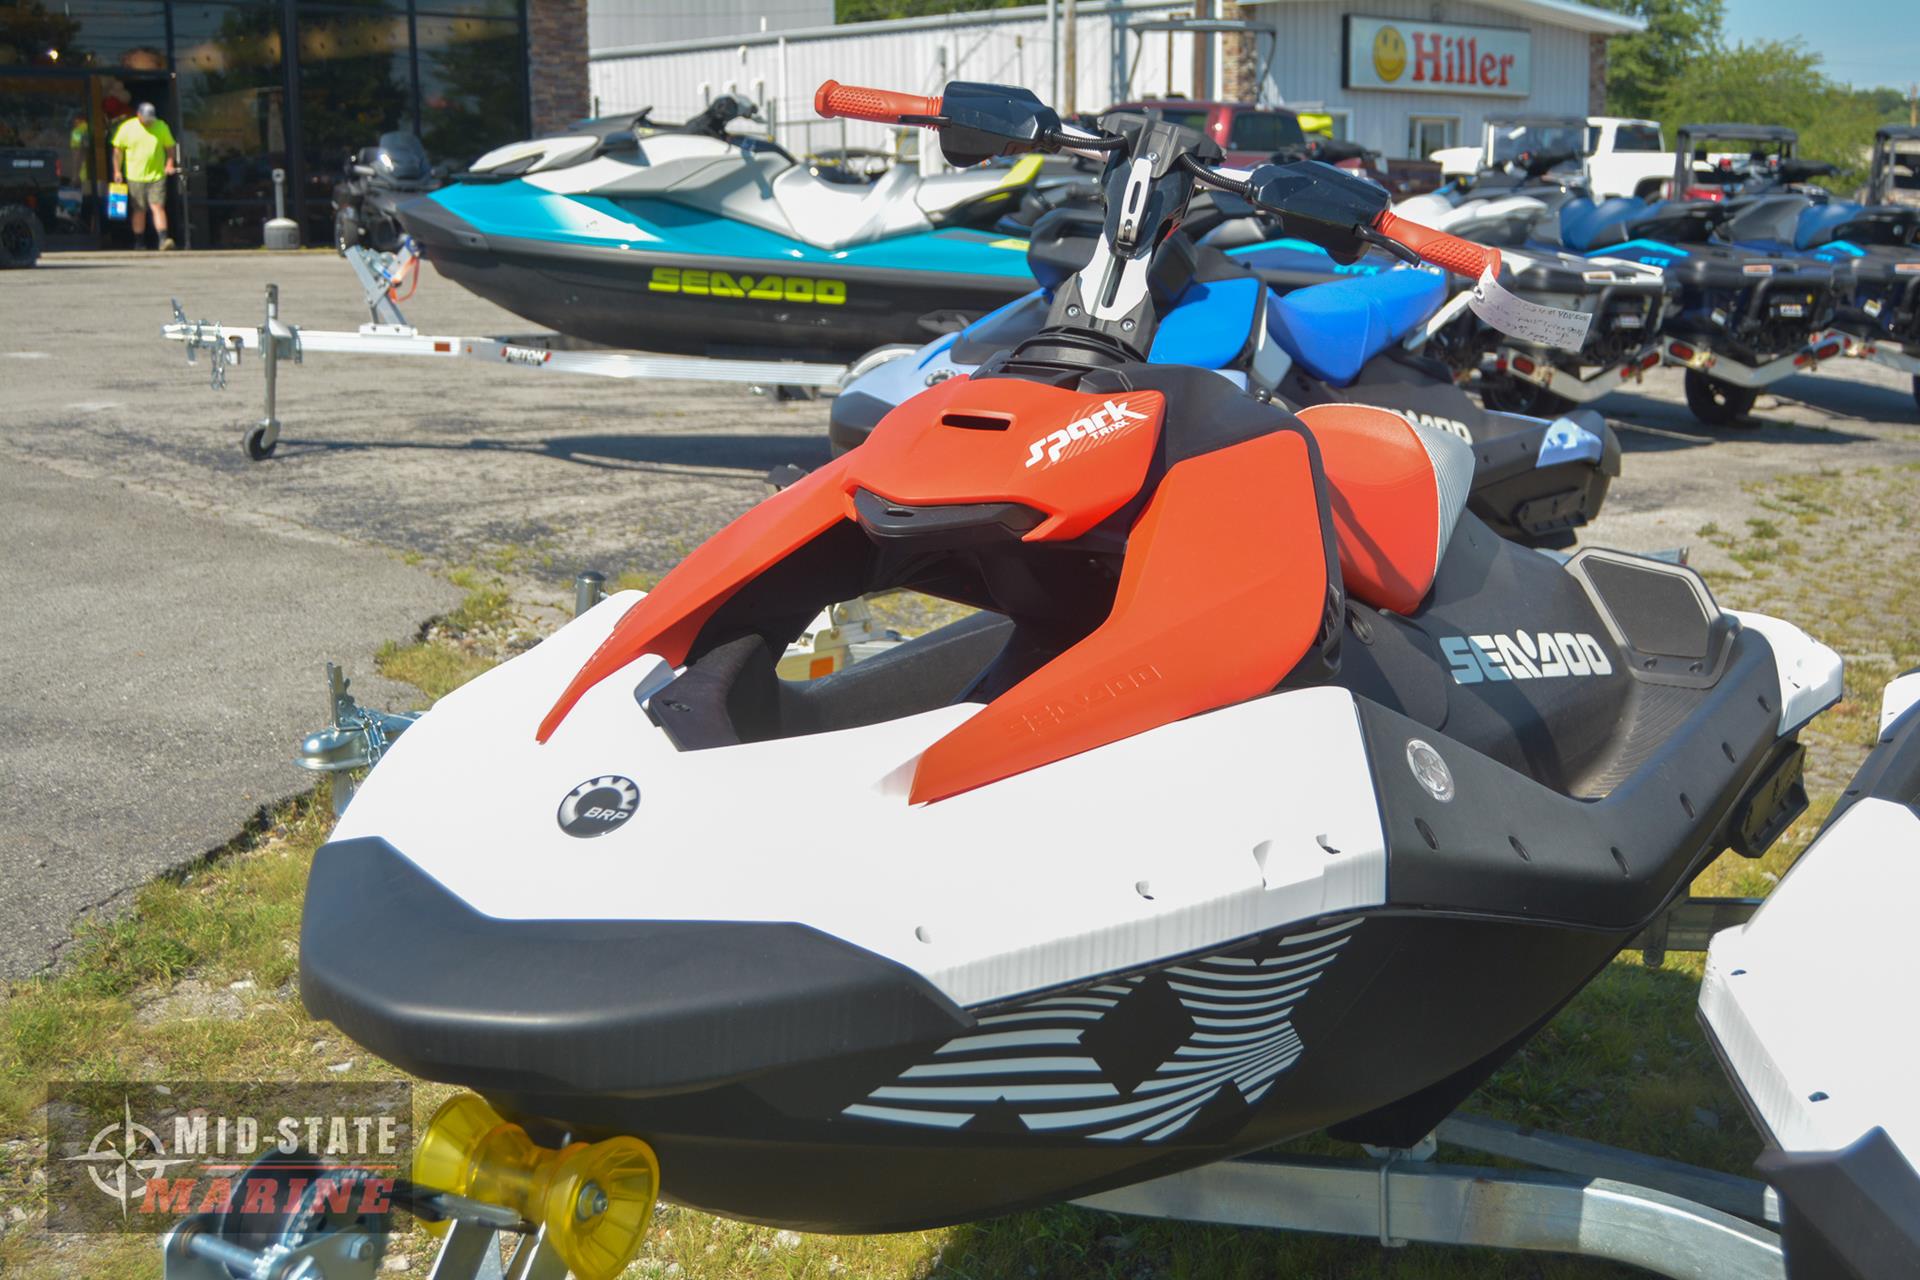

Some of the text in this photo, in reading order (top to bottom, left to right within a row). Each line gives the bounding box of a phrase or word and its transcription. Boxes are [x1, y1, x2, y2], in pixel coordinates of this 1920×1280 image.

[1411, 31, 1515, 87] Hiller
[1089, 420, 1130, 440] TRIXX
[583, 806, 629, 821] BRP
